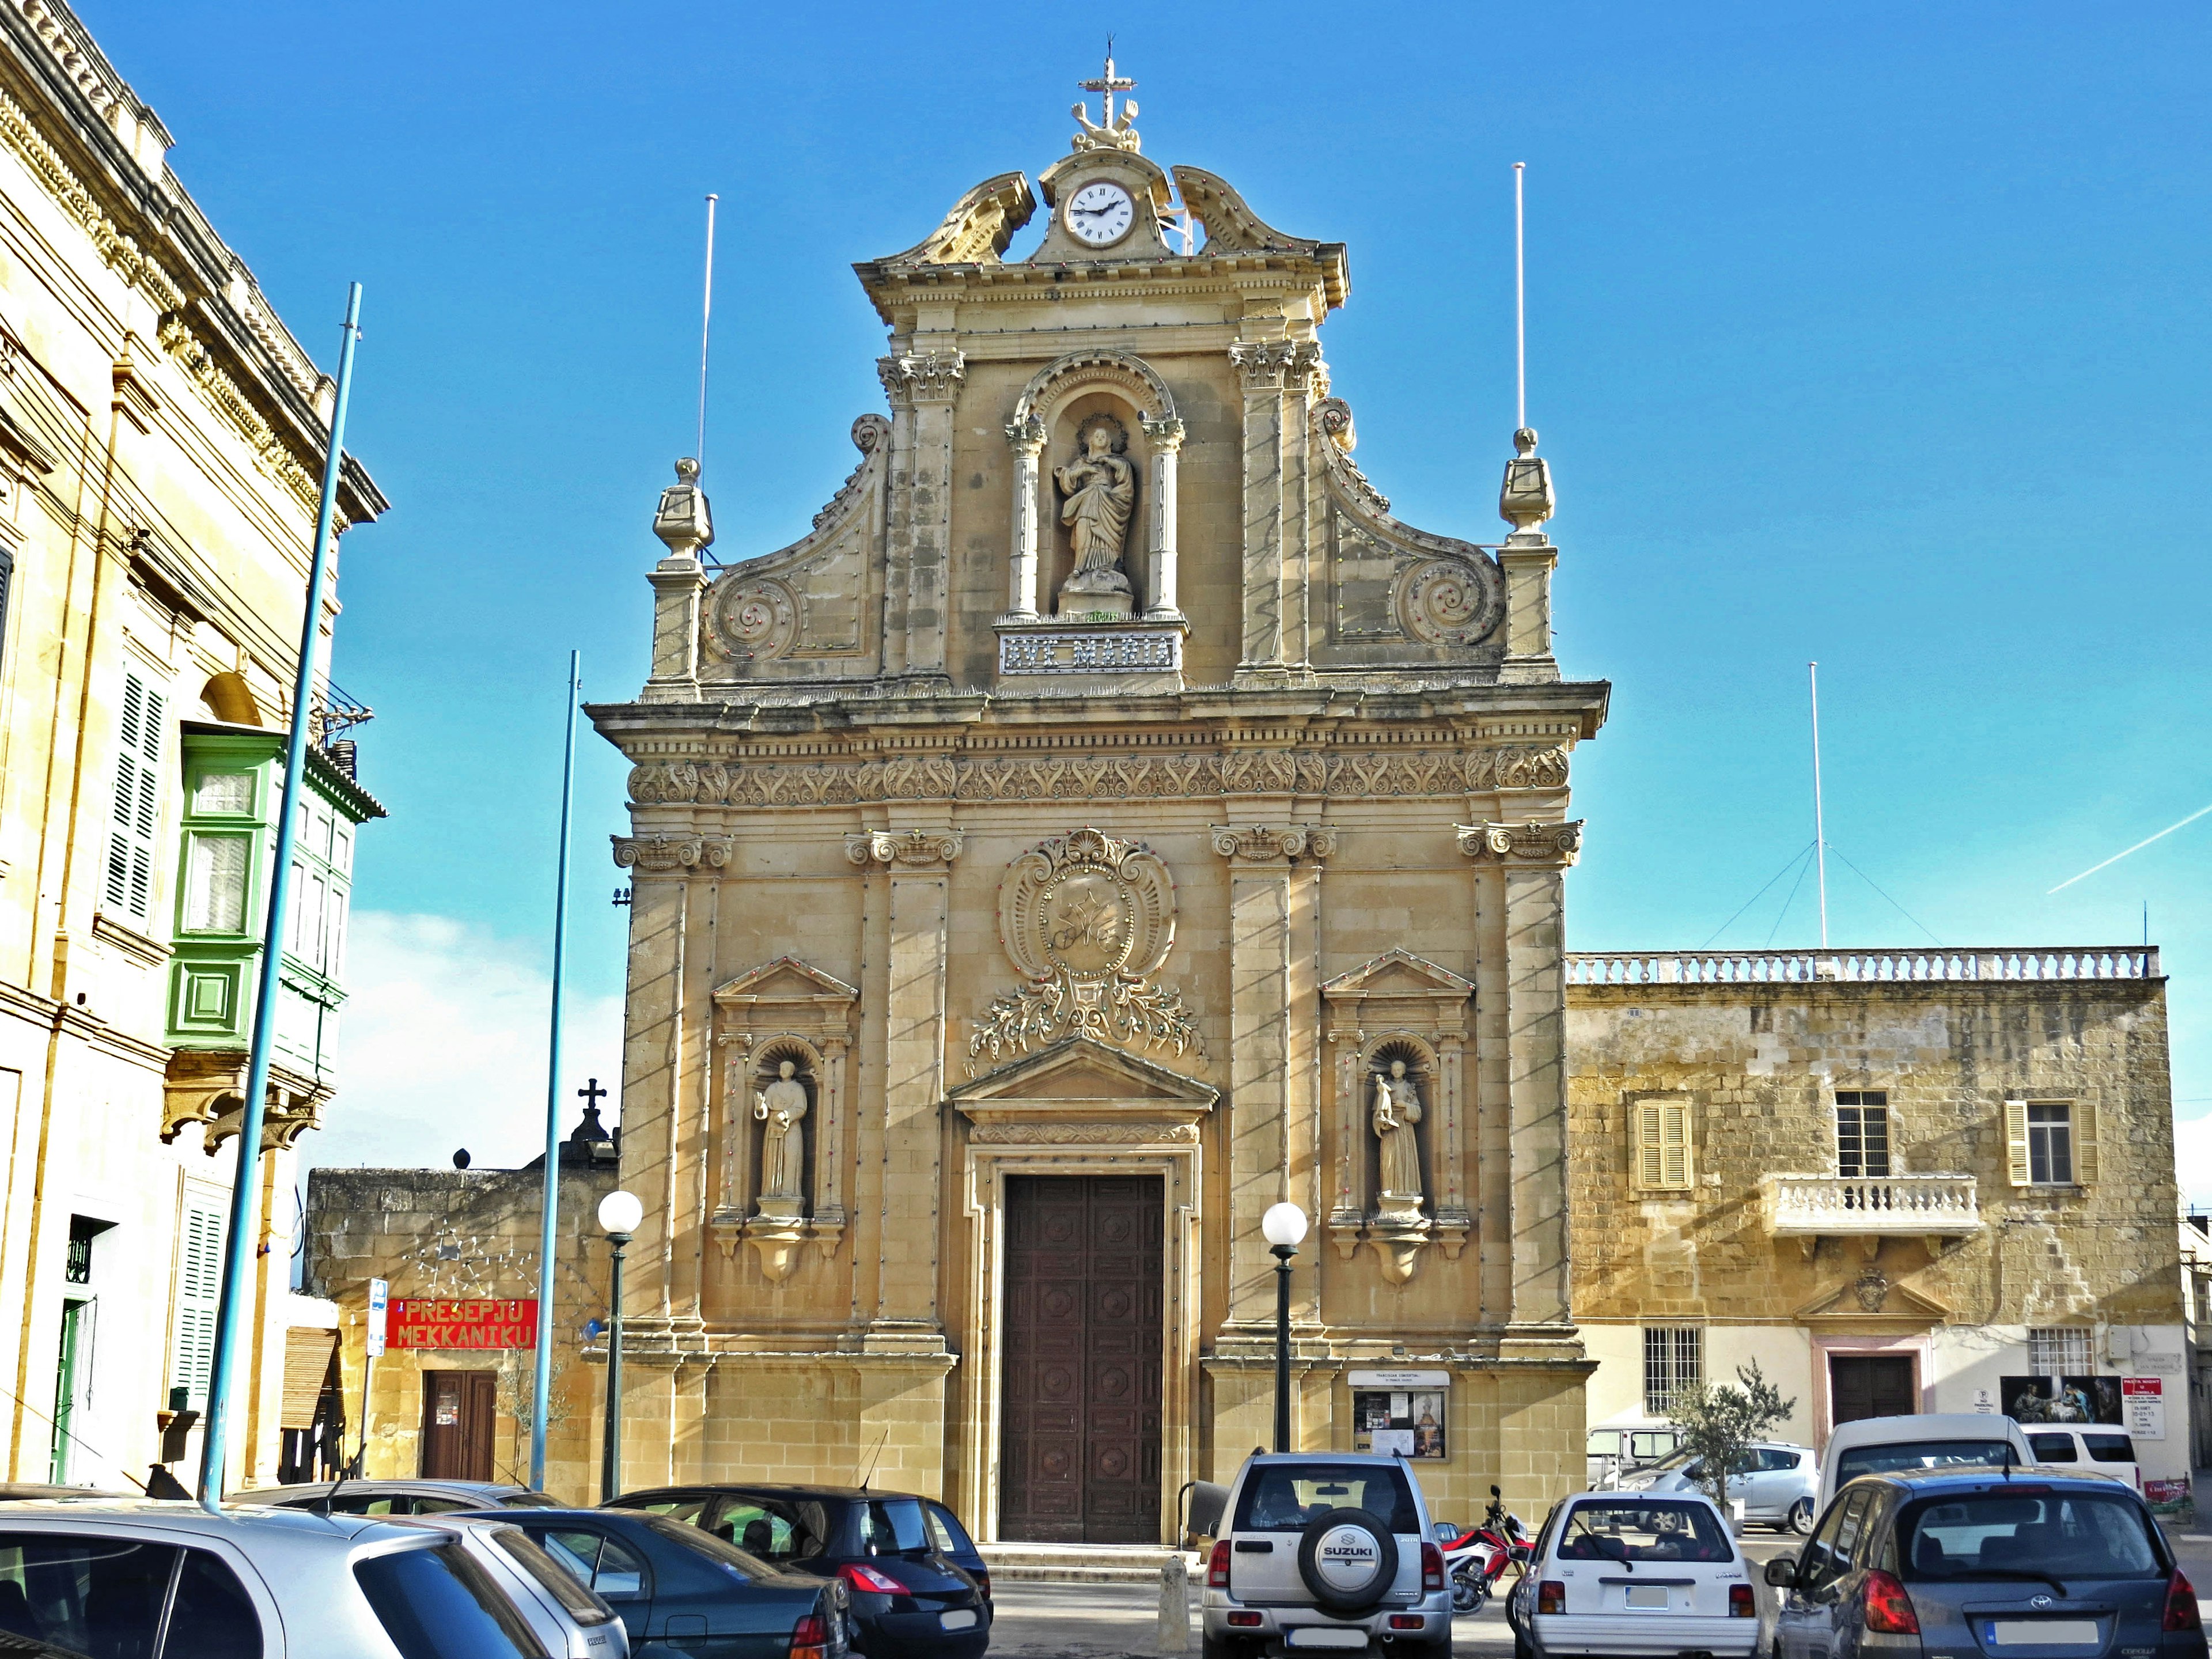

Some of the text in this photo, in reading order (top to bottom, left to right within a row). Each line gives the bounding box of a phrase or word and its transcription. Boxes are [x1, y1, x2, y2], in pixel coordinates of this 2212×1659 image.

[1005, 637, 1171, 666] AVE MARIA
[406, 1301, 524, 1323] PRESEPJU
[397, 1325, 531, 1347] MEKKANIKU
[1324, 1547, 1372, 1556] SUZUKI
